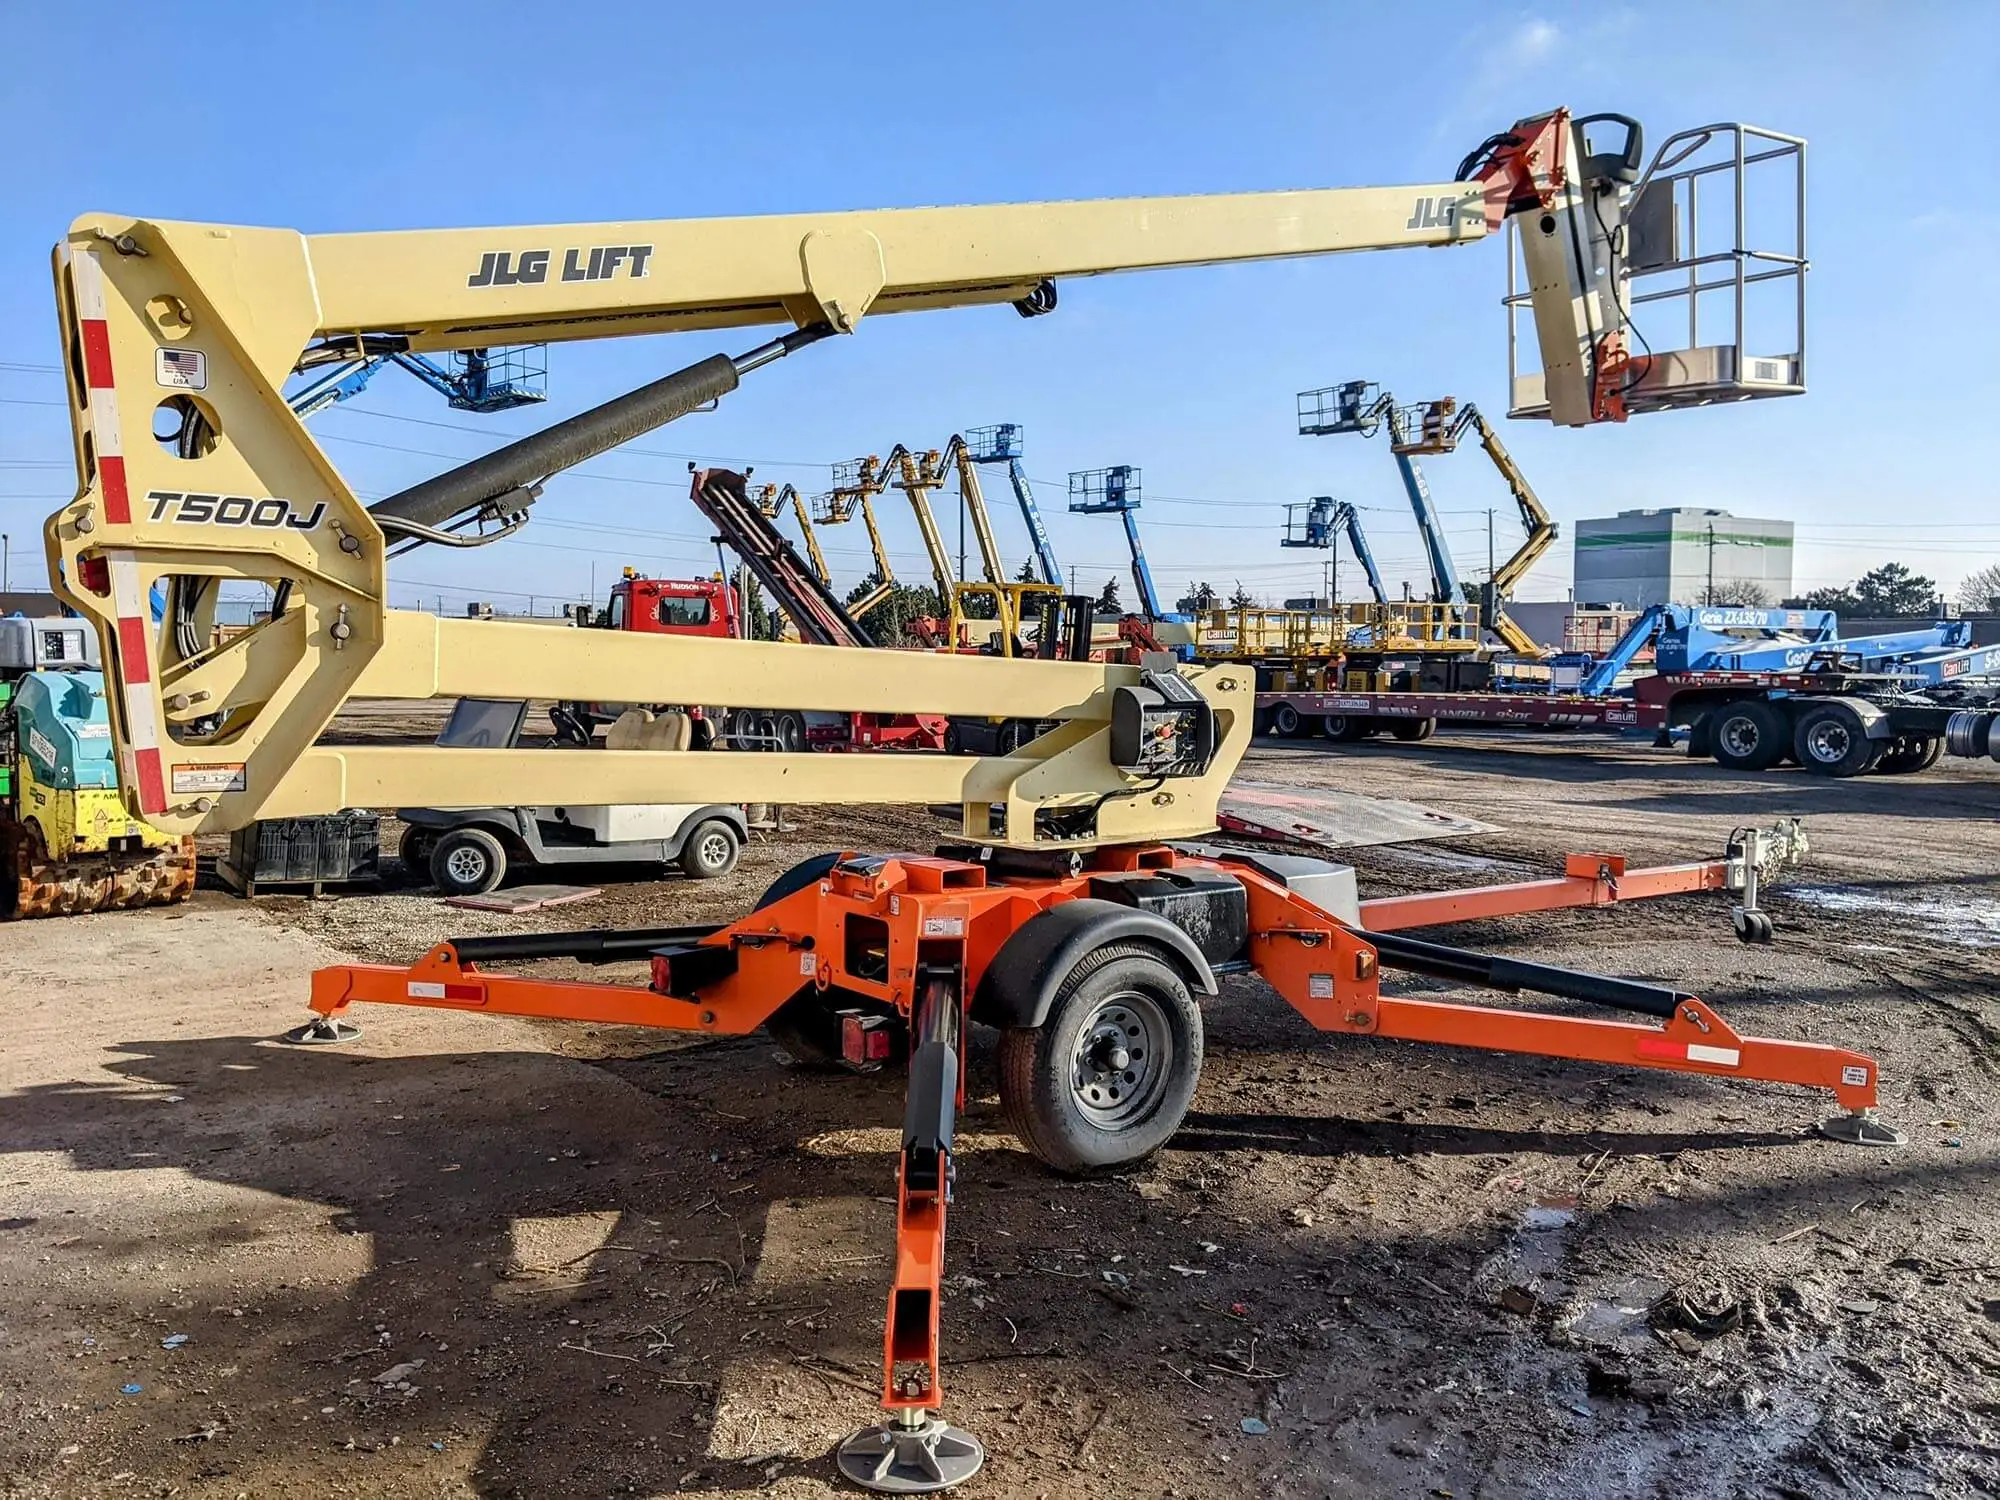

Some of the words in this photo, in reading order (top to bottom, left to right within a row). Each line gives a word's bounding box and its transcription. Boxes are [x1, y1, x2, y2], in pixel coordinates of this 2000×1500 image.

[1406, 195, 1457, 231] JLG
[468, 250, 551, 288] JLG
[561, 245, 653, 282] LIFT
[147, 491, 327, 530] T500J
[1700, 611, 1722, 625] Genie
